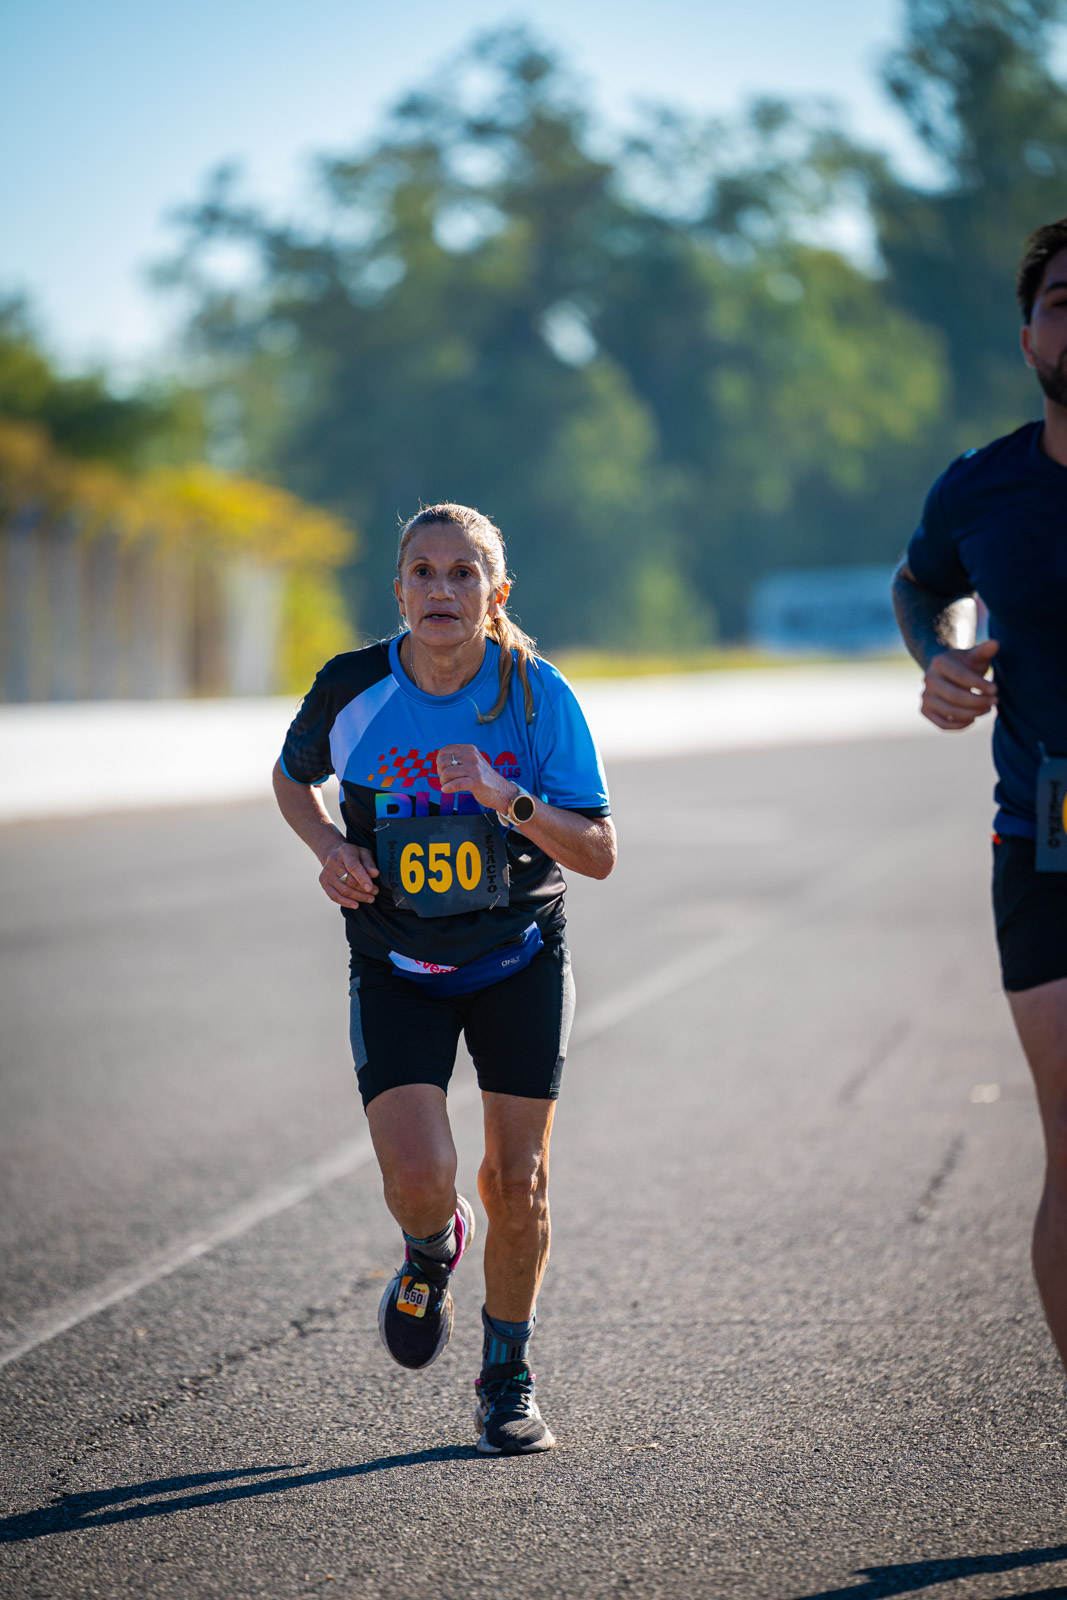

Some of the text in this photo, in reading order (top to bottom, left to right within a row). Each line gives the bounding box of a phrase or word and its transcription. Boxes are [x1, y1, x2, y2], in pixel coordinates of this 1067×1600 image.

[400, 841, 482, 893] 650
[485, 834, 497, 893] EXACTO
[404, 1291, 423, 1304] 650
